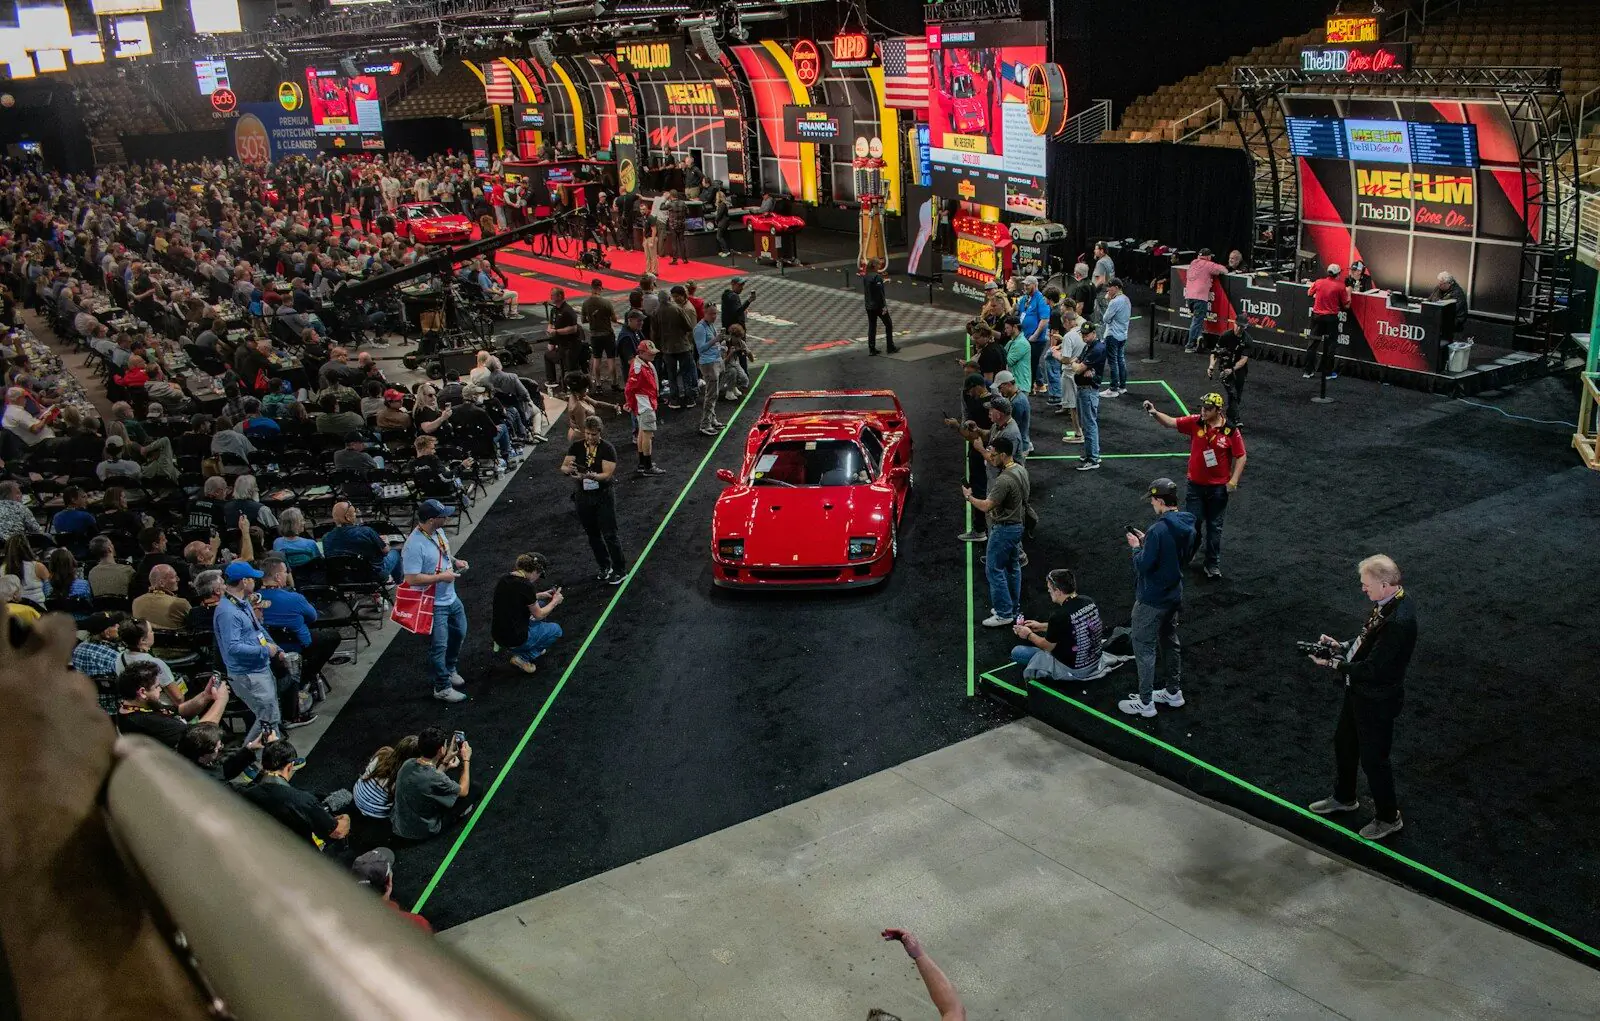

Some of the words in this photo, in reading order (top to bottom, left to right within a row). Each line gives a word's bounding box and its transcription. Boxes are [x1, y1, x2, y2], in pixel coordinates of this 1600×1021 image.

[834, 36, 867, 60] NPD
[626, 43, 671, 72] $400,000
[214, 92, 233, 105] 303
[279, 116, 309, 126] PREMIUM
[798, 121, 837, 131] FINANCIAL
[282, 140, 318, 149] CLEANERS
[1350, 128, 1404, 144] MECUM
[239, 135, 267, 160] 303
[1357, 168, 1473, 205] MECUM
[1415, 206, 1442, 225] Goes
